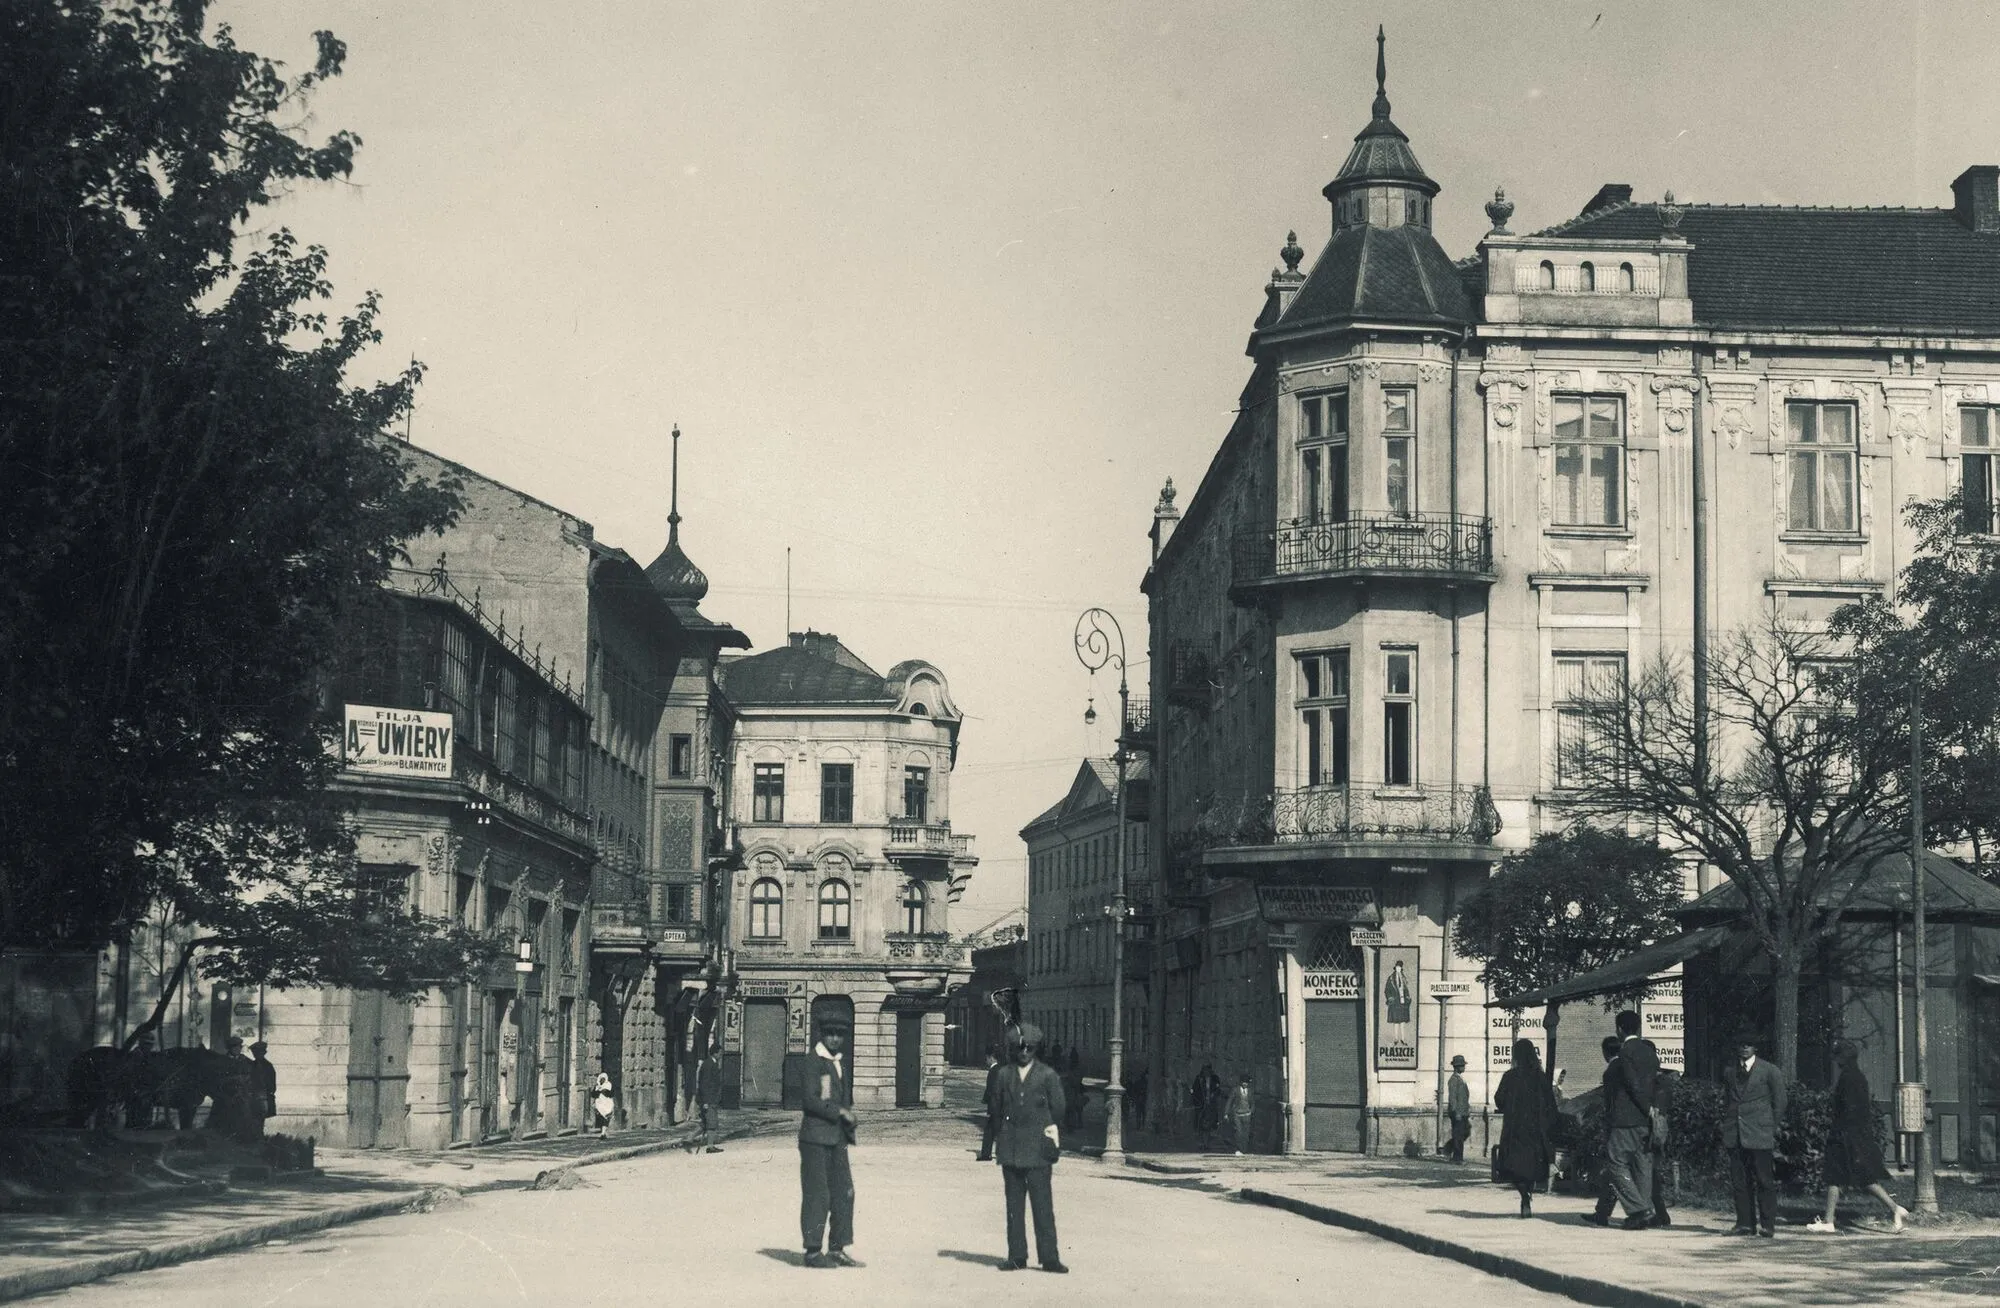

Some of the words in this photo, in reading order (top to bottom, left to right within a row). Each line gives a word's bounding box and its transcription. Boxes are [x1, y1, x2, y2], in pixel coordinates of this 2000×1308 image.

[376, 711, 422, 723] FILJA
[378, 722, 451, 759] UWIERY
[400, 760, 447, 772] BŁAWATNYCH
[664, 931, 686, 939] APTEKA
[1451, 984, 1470, 993] DAMSKIE
[1492, 1018, 1541, 1028] SZLAROKI
[1379, 1046, 1415, 1057] PŁASZCZE
